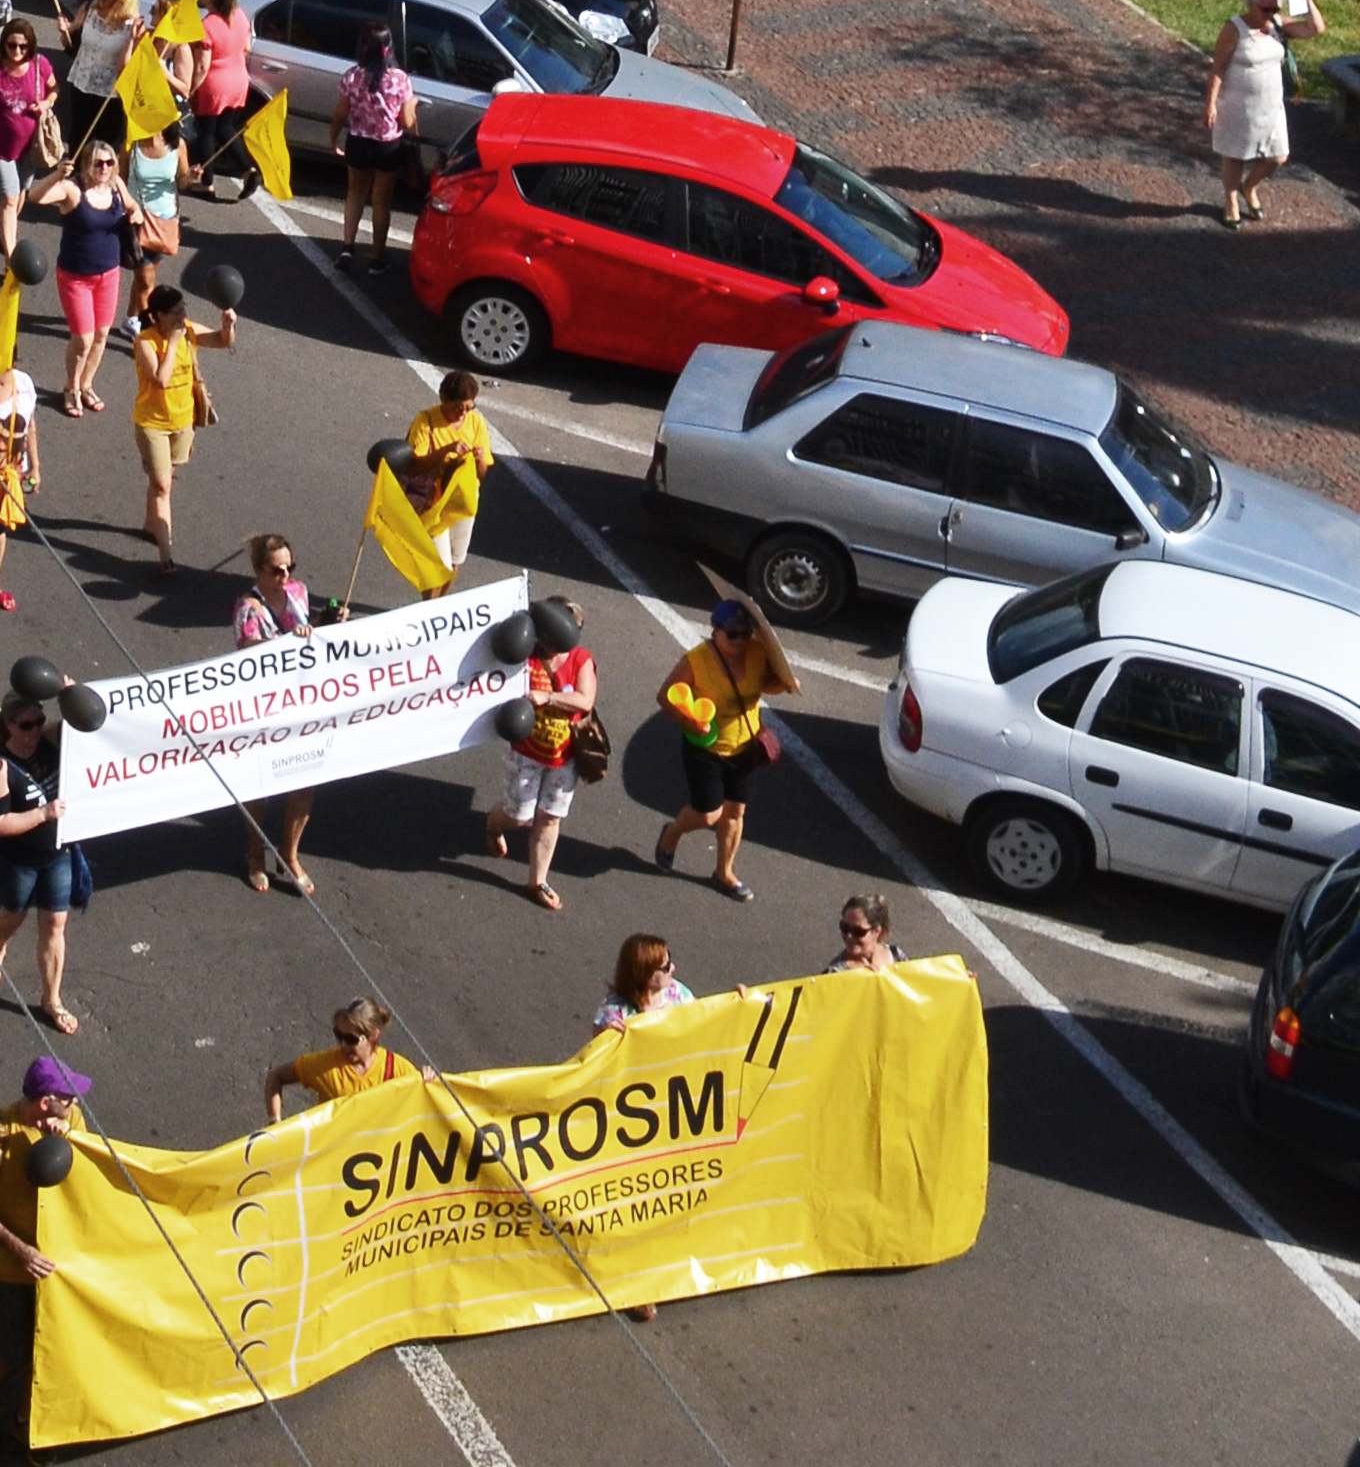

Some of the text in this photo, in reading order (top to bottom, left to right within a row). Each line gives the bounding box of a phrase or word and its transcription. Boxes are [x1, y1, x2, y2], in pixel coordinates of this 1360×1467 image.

[107, 603, 492, 715] PROFESSORES MUNICIPAIS
[161, 653, 442, 740] MOBILIZADOS PELA
[86, 668, 507, 790] VALORIZAÇÃO DA EDUCAÇÃO
[271, 748, 325, 769] SINPROSM
[341, 1070, 725, 1219] SINPROSM
[341, 1158, 724, 1261] SINDICATO DOS PROFESSORES
[344, 1188, 708, 1278] MUNICIPAIS DE SANTA MARIA
